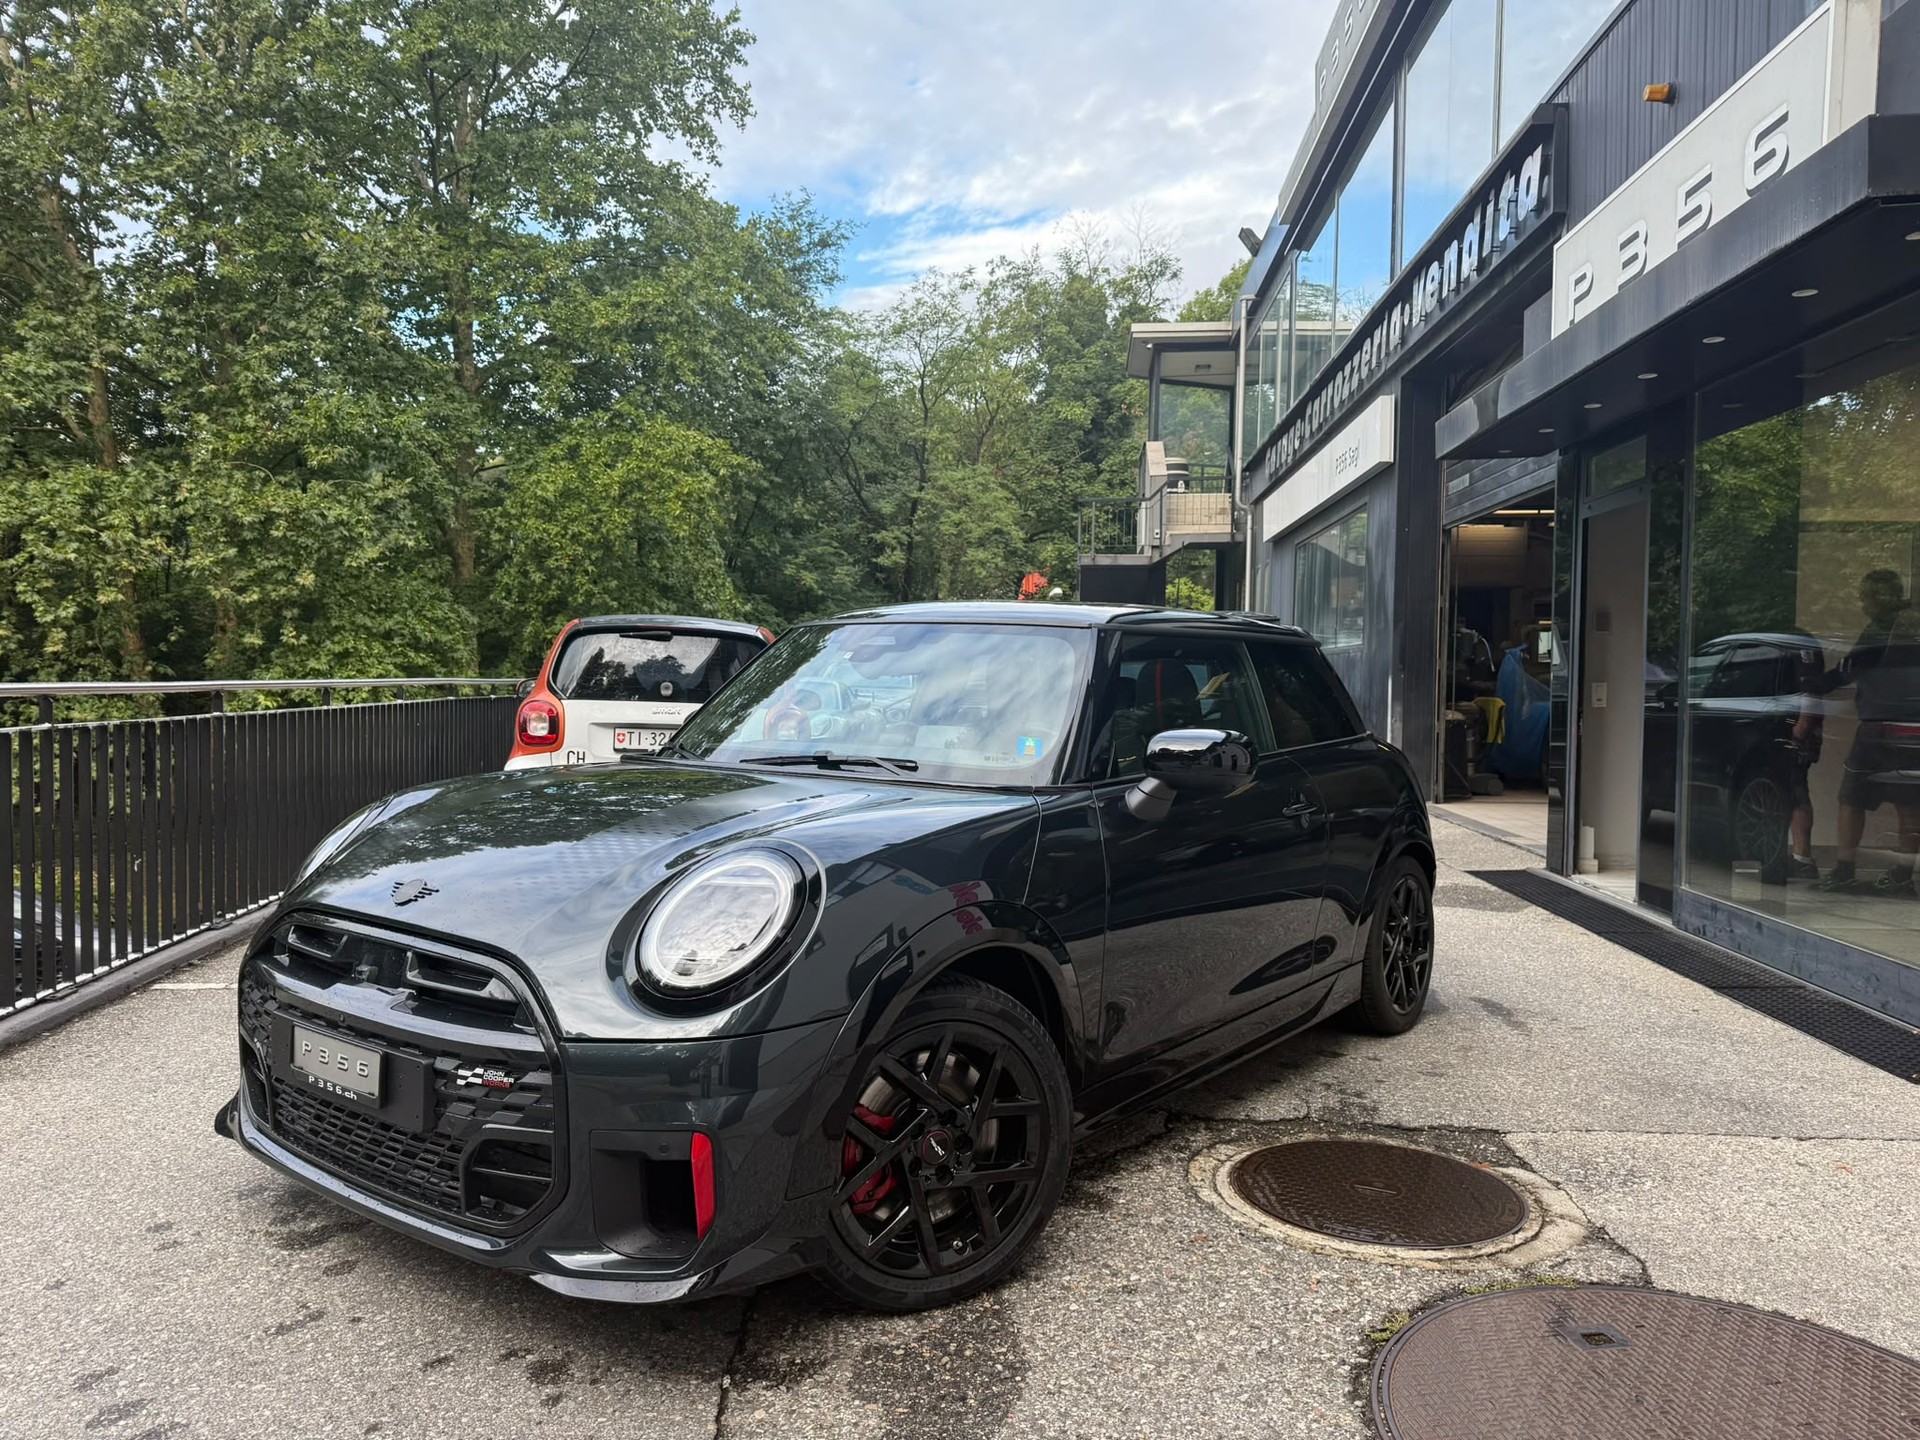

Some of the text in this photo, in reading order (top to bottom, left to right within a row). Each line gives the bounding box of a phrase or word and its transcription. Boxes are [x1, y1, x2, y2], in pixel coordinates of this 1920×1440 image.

[652, 706, 682, 715] smart
[567, 751, 586, 763] CH
[484, 1069, 505, 1077] JOHN
[483, 1074, 514, 1083] COOPER
[483, 1080, 510, 1089] WORKS
